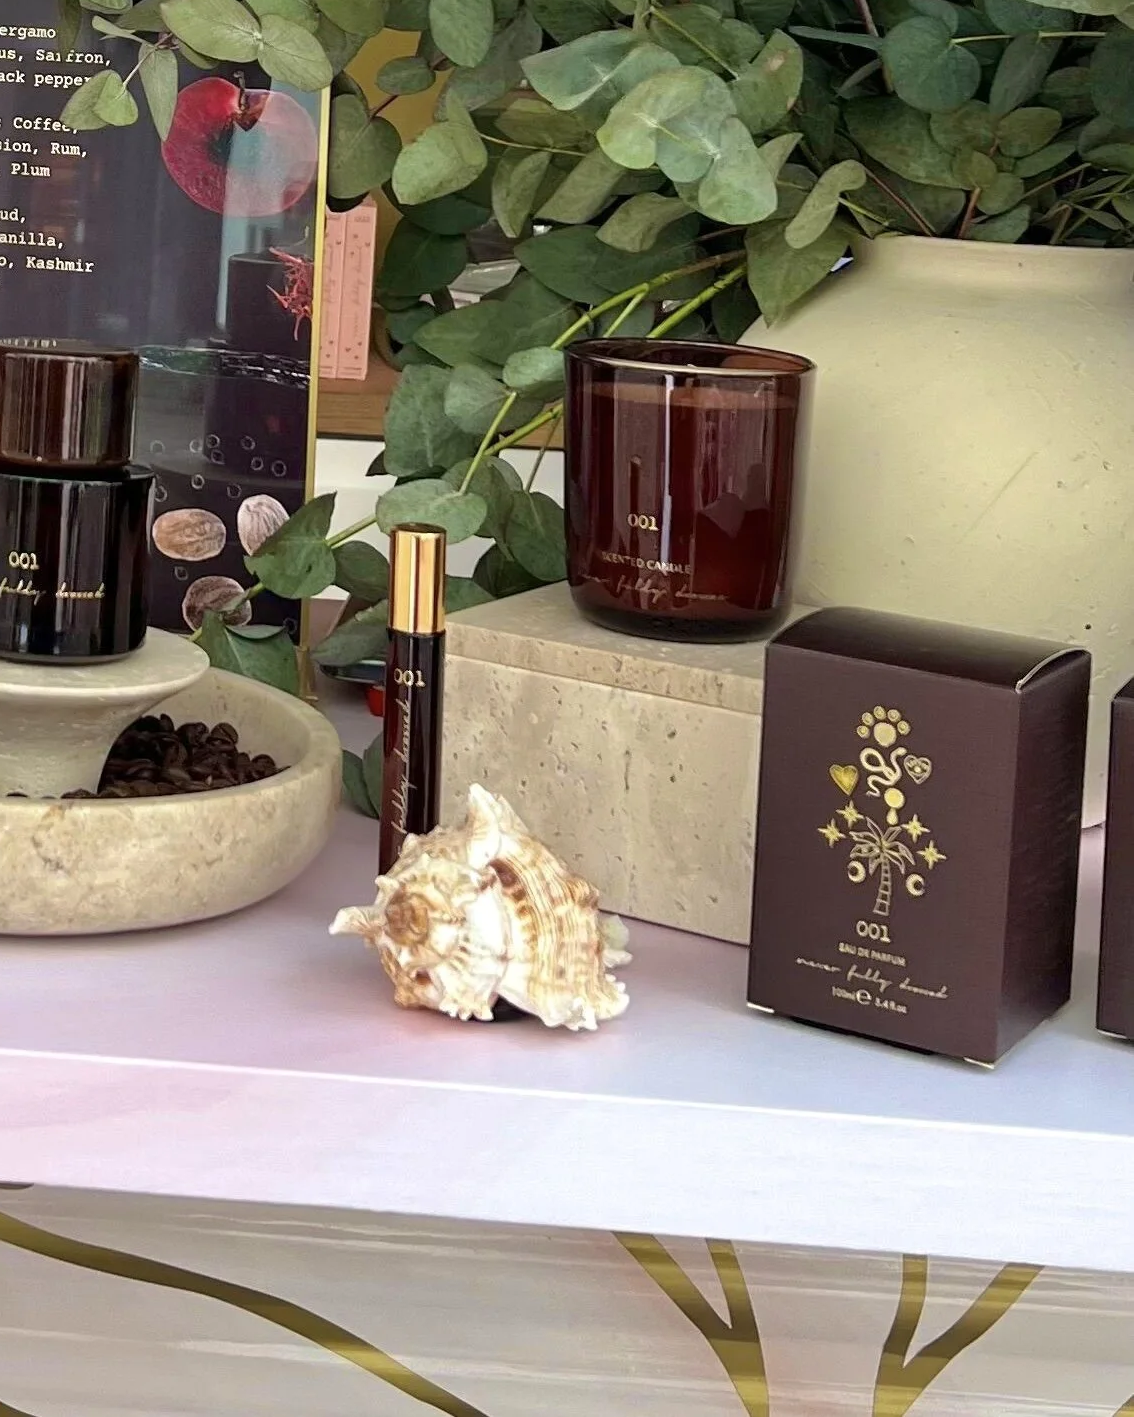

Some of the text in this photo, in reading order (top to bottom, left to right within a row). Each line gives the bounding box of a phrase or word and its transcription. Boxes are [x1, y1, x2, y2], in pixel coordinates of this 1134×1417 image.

[51, 142, 87, 158] Rum,
[11, 163, 51, 177] Plum
[26, 256, 95, 273] Kashmir
[628, 513, 659, 531] 001
[9, 551, 39, 570] 001
[393, 668, 426, 687] 001
[856, 920, 890, 942] 001
